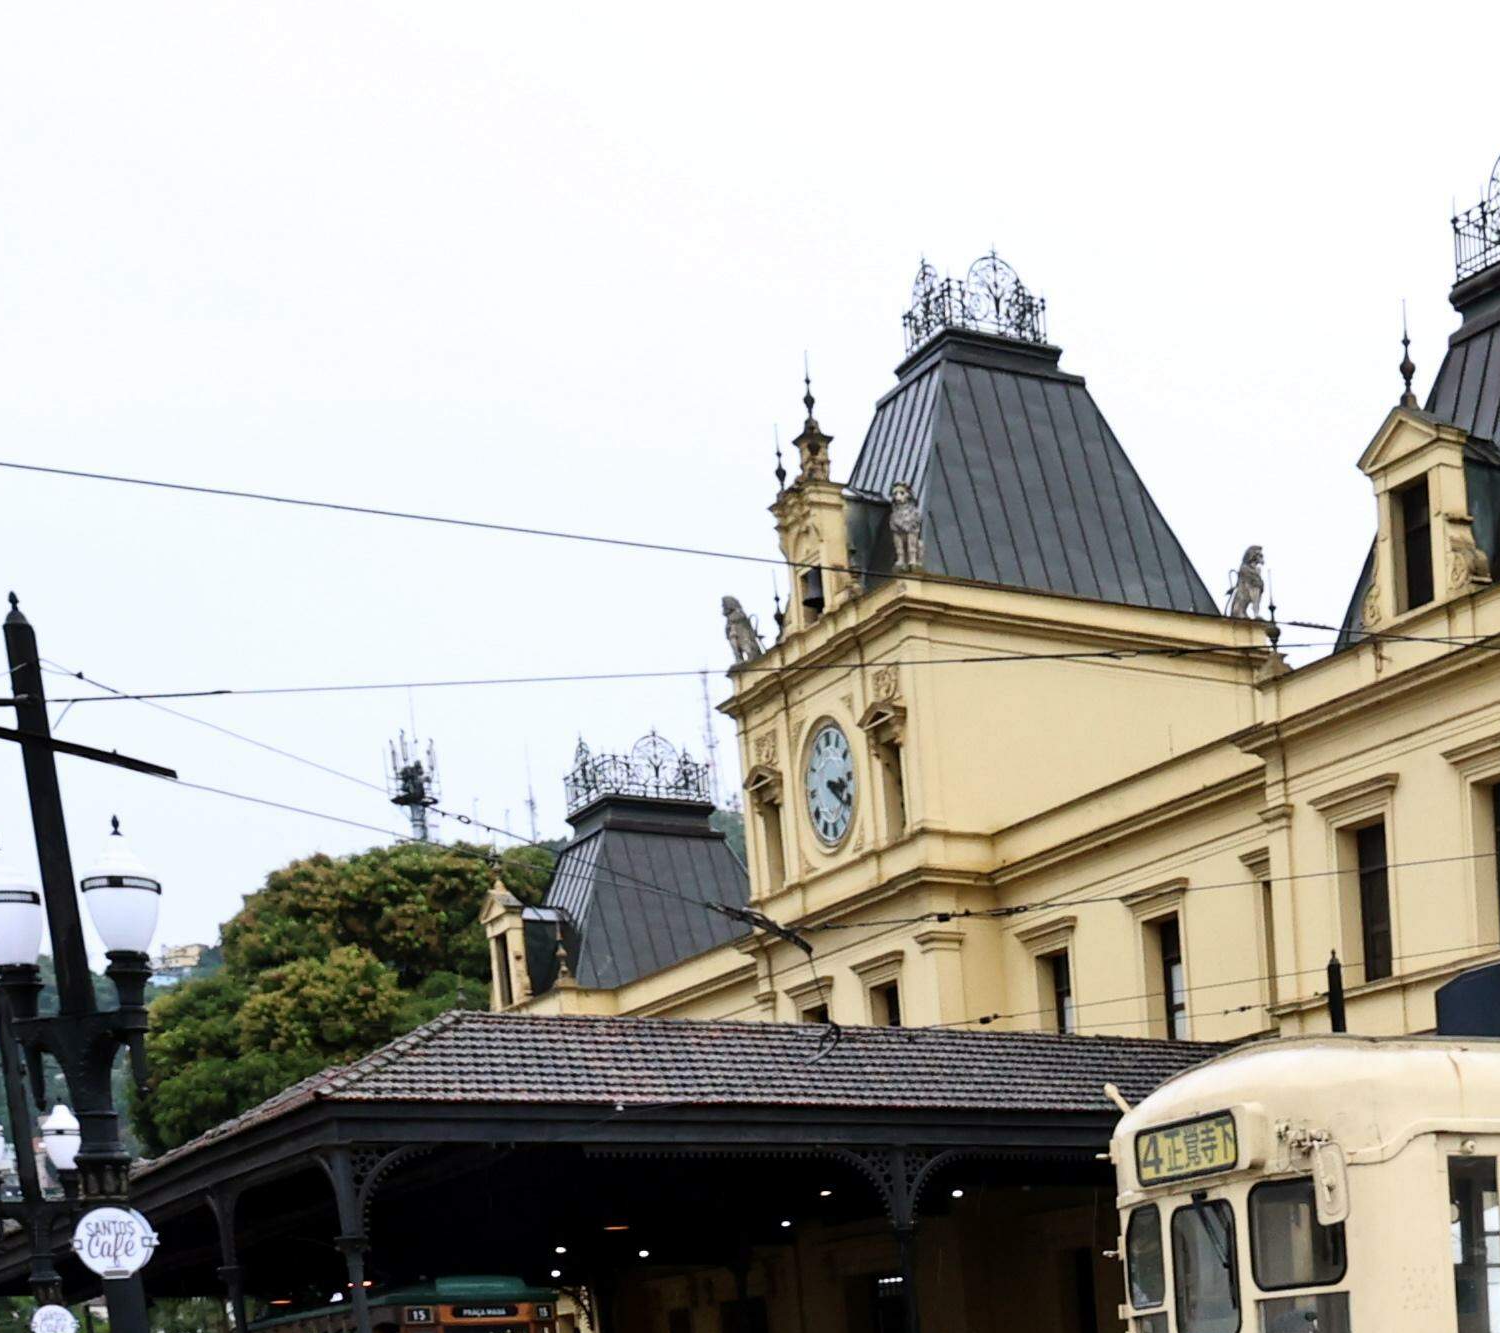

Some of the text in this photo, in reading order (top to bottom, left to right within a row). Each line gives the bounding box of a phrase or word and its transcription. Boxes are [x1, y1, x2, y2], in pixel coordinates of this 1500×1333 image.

[1142, 1134, 1163, 1174] 4
[85, 1220, 135, 1236] SANTOS
[88, 1232, 136, 1262] Café
[412, 1310, 426, 1321] 15
